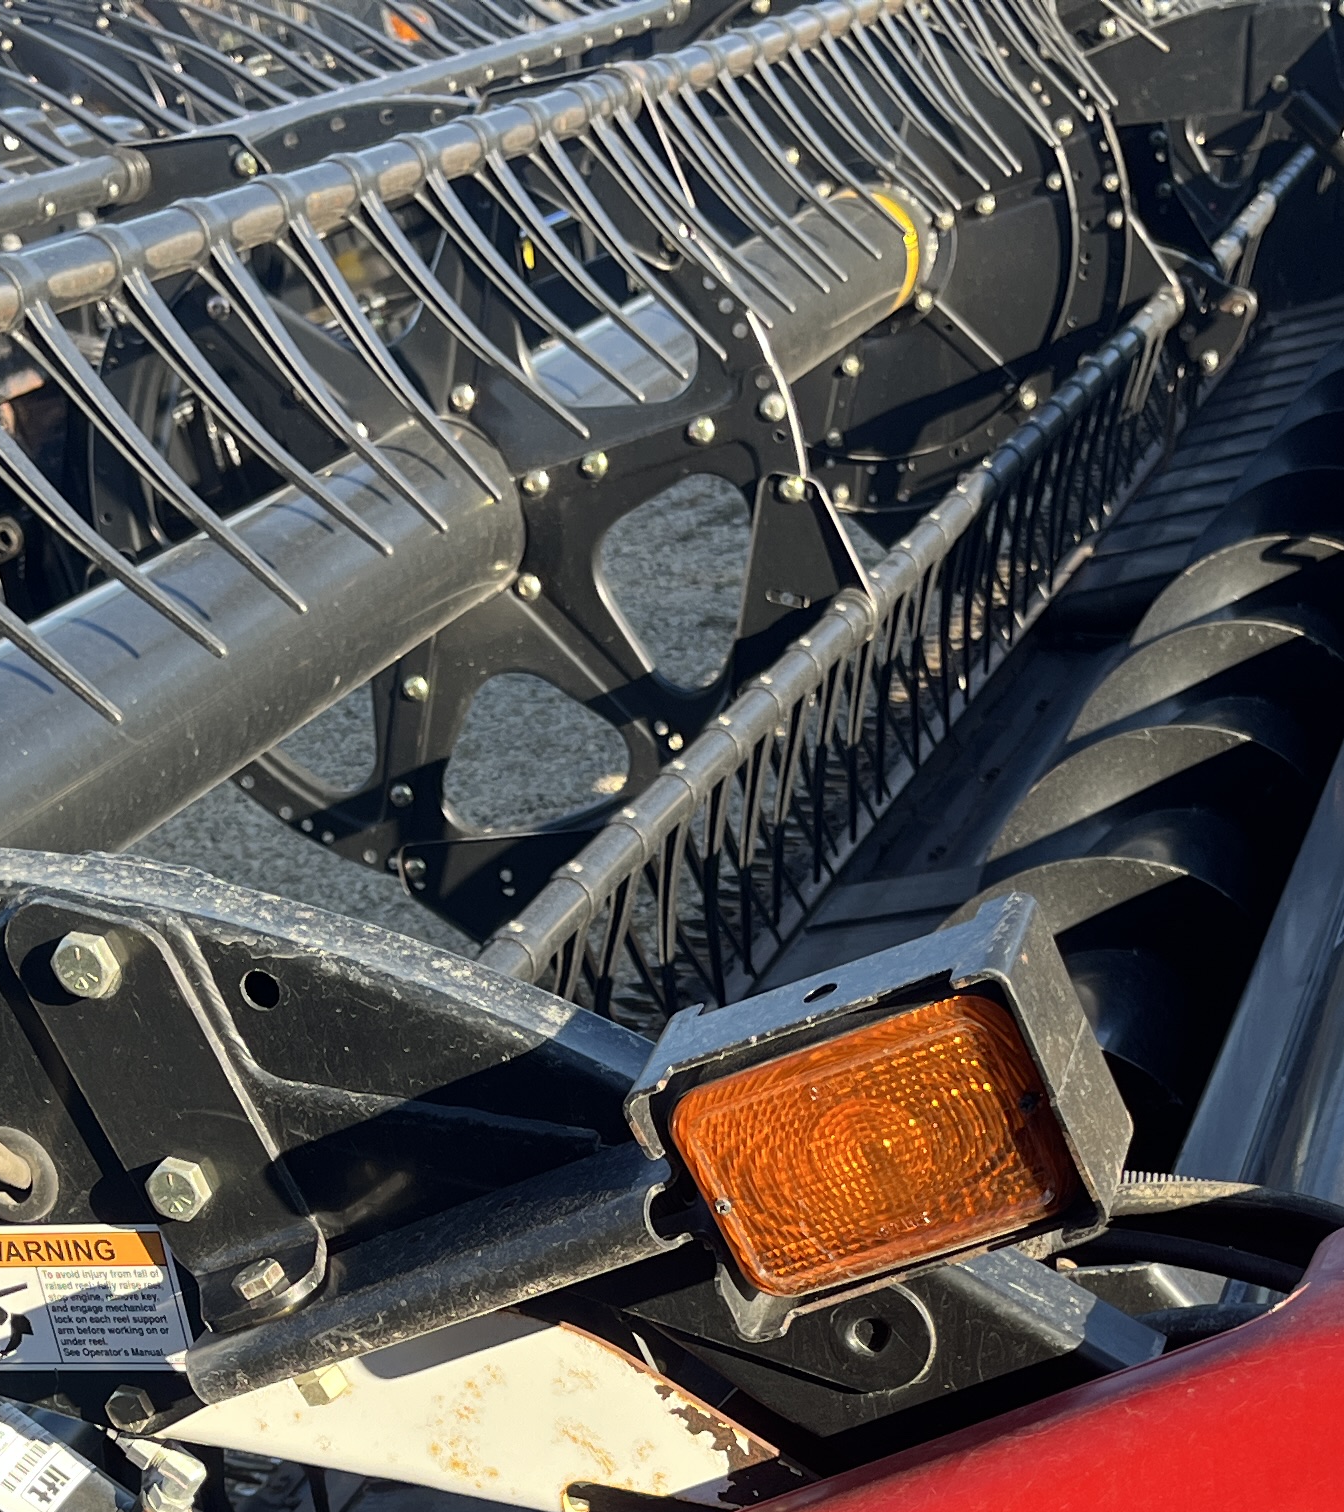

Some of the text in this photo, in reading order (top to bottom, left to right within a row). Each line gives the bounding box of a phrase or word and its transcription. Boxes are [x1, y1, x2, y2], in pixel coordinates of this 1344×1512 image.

[41, 1269, 159, 1280] To avoid injury from fall of
[45, 1281, 73, 1290] raised
[118, 1281, 141, 1290] raise
[48, 1293, 68, 1303] stop
[70, 1292, 104, 1303] engine,
[141, 1291, 160, 1302] key,
[51, 1303, 157, 1315] and engage mechanical
[54, 1314, 168, 1325] lock on each reel support
[57, 1325, 169, 1336] arm before working on or
[60, 1337, 109, 1346] under reel.
[63, 1347, 166, 1358] See Operator's Manual.
[27, 1463, 72, 1504] lift
